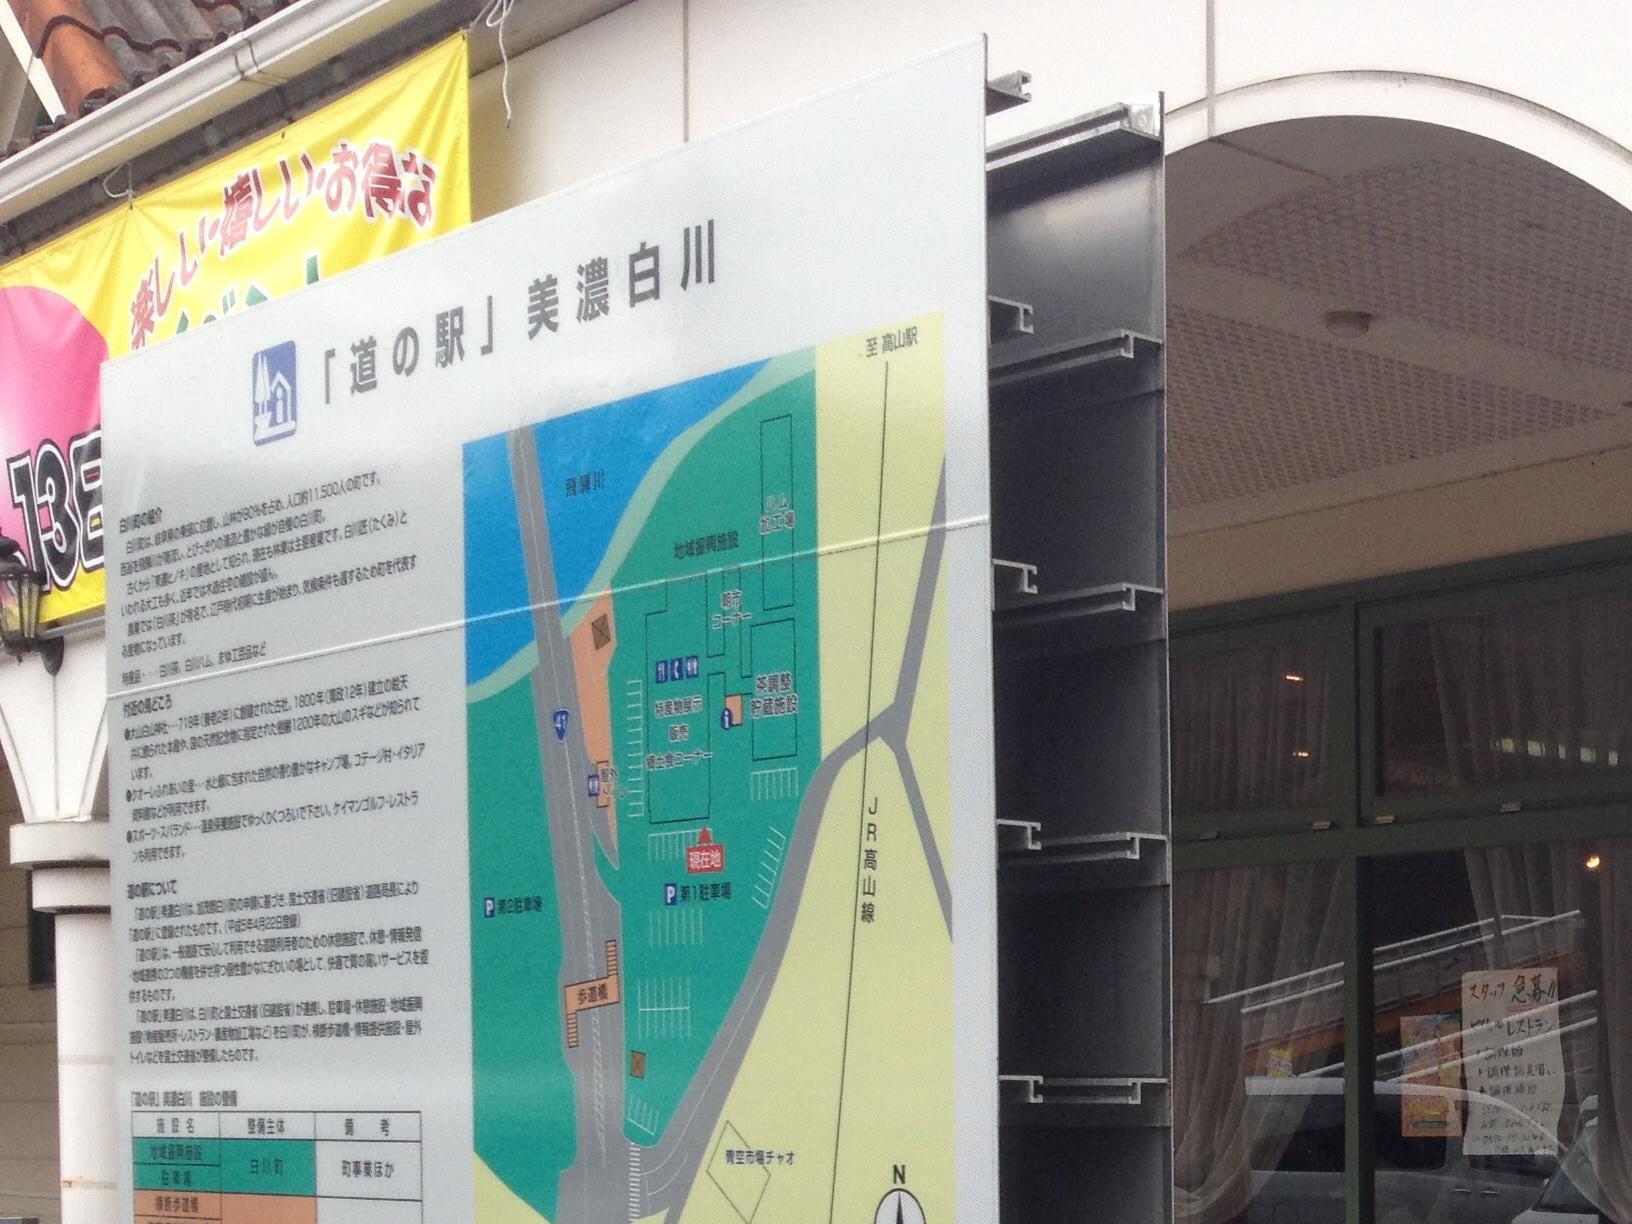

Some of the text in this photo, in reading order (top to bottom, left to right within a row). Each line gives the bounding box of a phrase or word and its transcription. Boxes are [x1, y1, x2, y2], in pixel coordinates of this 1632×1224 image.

[882, 326, 918, 355] 高山駅
[893, 1164, 906, 1185] N
